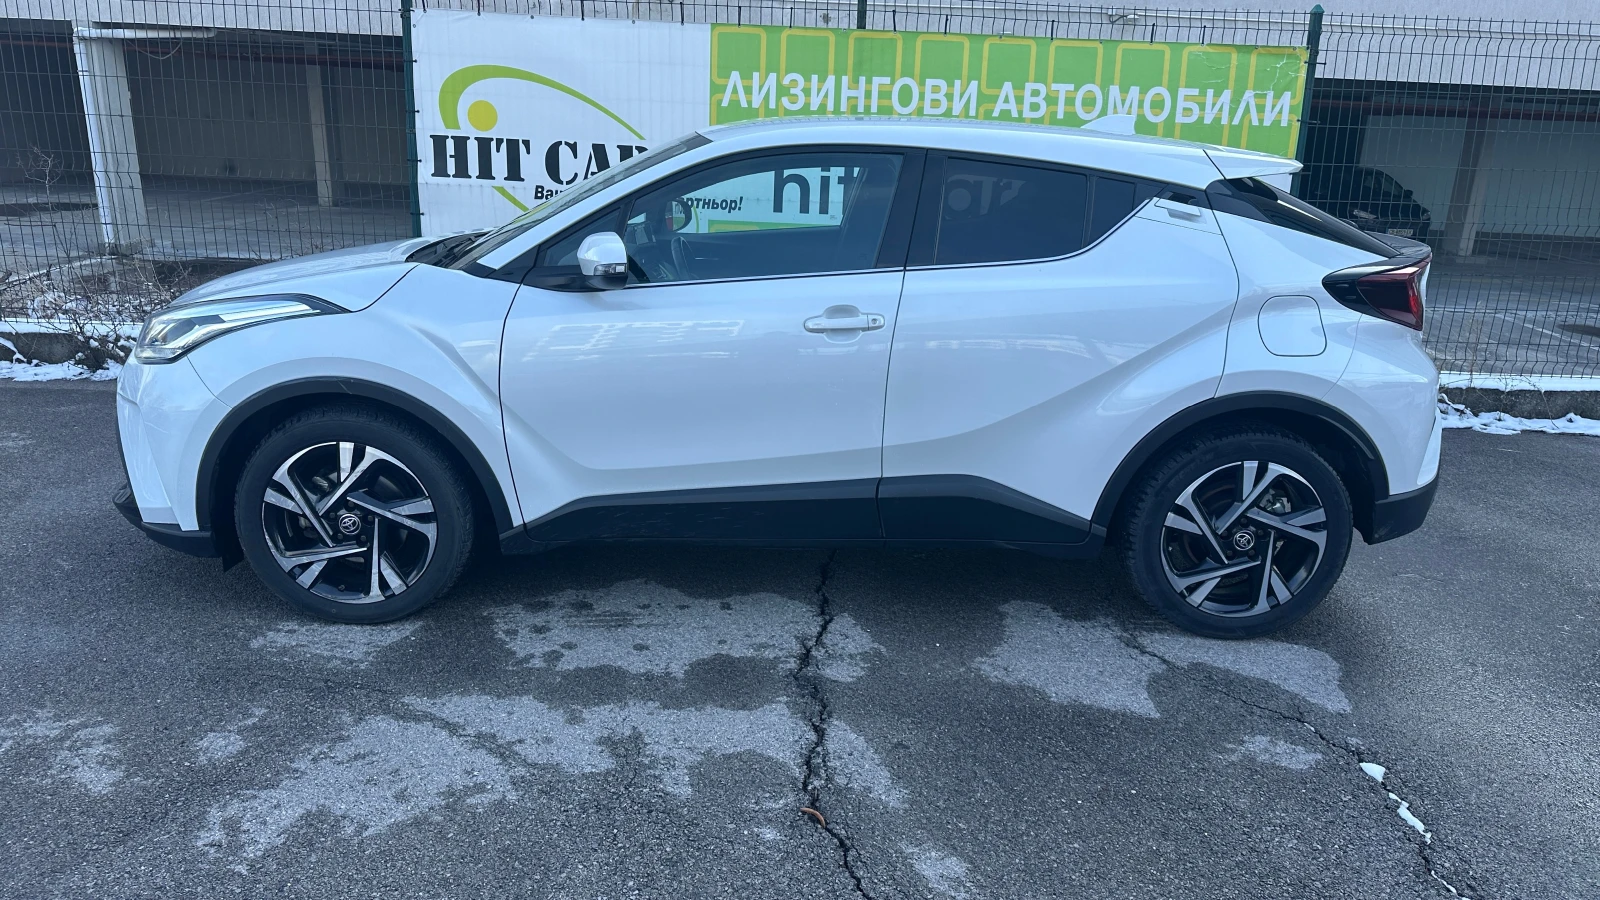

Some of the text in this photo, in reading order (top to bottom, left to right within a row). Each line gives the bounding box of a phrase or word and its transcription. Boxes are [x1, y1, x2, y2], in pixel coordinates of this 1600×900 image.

[721, 70, 1292, 127] ЛИЗИНГОВИ АВТОМОБИЛИ
[429, 134, 531, 182] HIT
[681, 196, 744, 214] ртньор!
